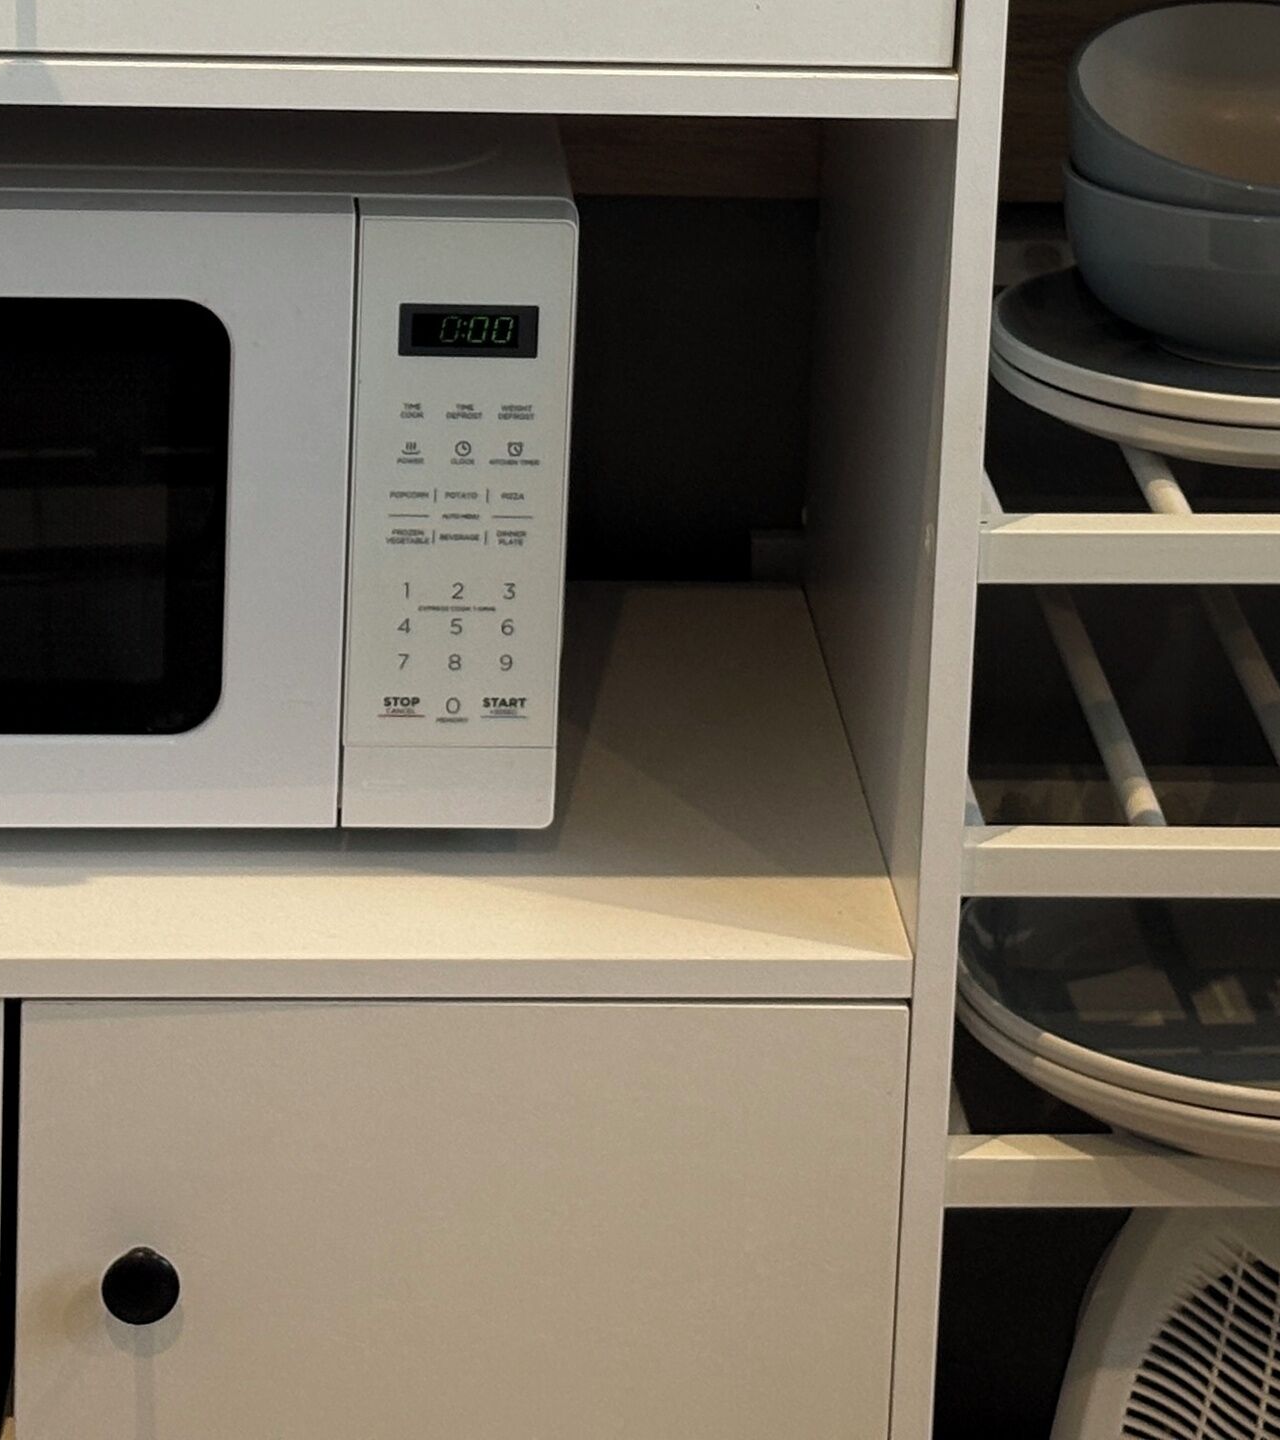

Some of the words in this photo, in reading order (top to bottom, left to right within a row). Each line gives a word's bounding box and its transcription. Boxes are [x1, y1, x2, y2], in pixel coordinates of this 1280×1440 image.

[400, 411, 424, 419] COOK
[446, 412, 483, 420] DEFROST
[498, 412, 535, 420] DEFROST
[389, 491, 430, 499] POPCORN
[445, 491, 479, 499] POTATO
[500, 492, 525, 500] PIZZA
[439, 533, 480, 542] BEVERAGE
[404, 582, 410, 599] 1
[451, 582, 464, 600] 2
[503, 583, 516, 600] 3
[397, 618, 411, 634] 4
[449, 618, 463, 635] 5
[501, 618, 514, 636] 6
[397, 654, 410, 670] 7
[447, 654, 462, 671] 8
[499, 654, 513, 671] 9
[383, 696, 420, 707] STOP
[445, 697, 461, 714] 0
[482, 697, 527, 708] START
